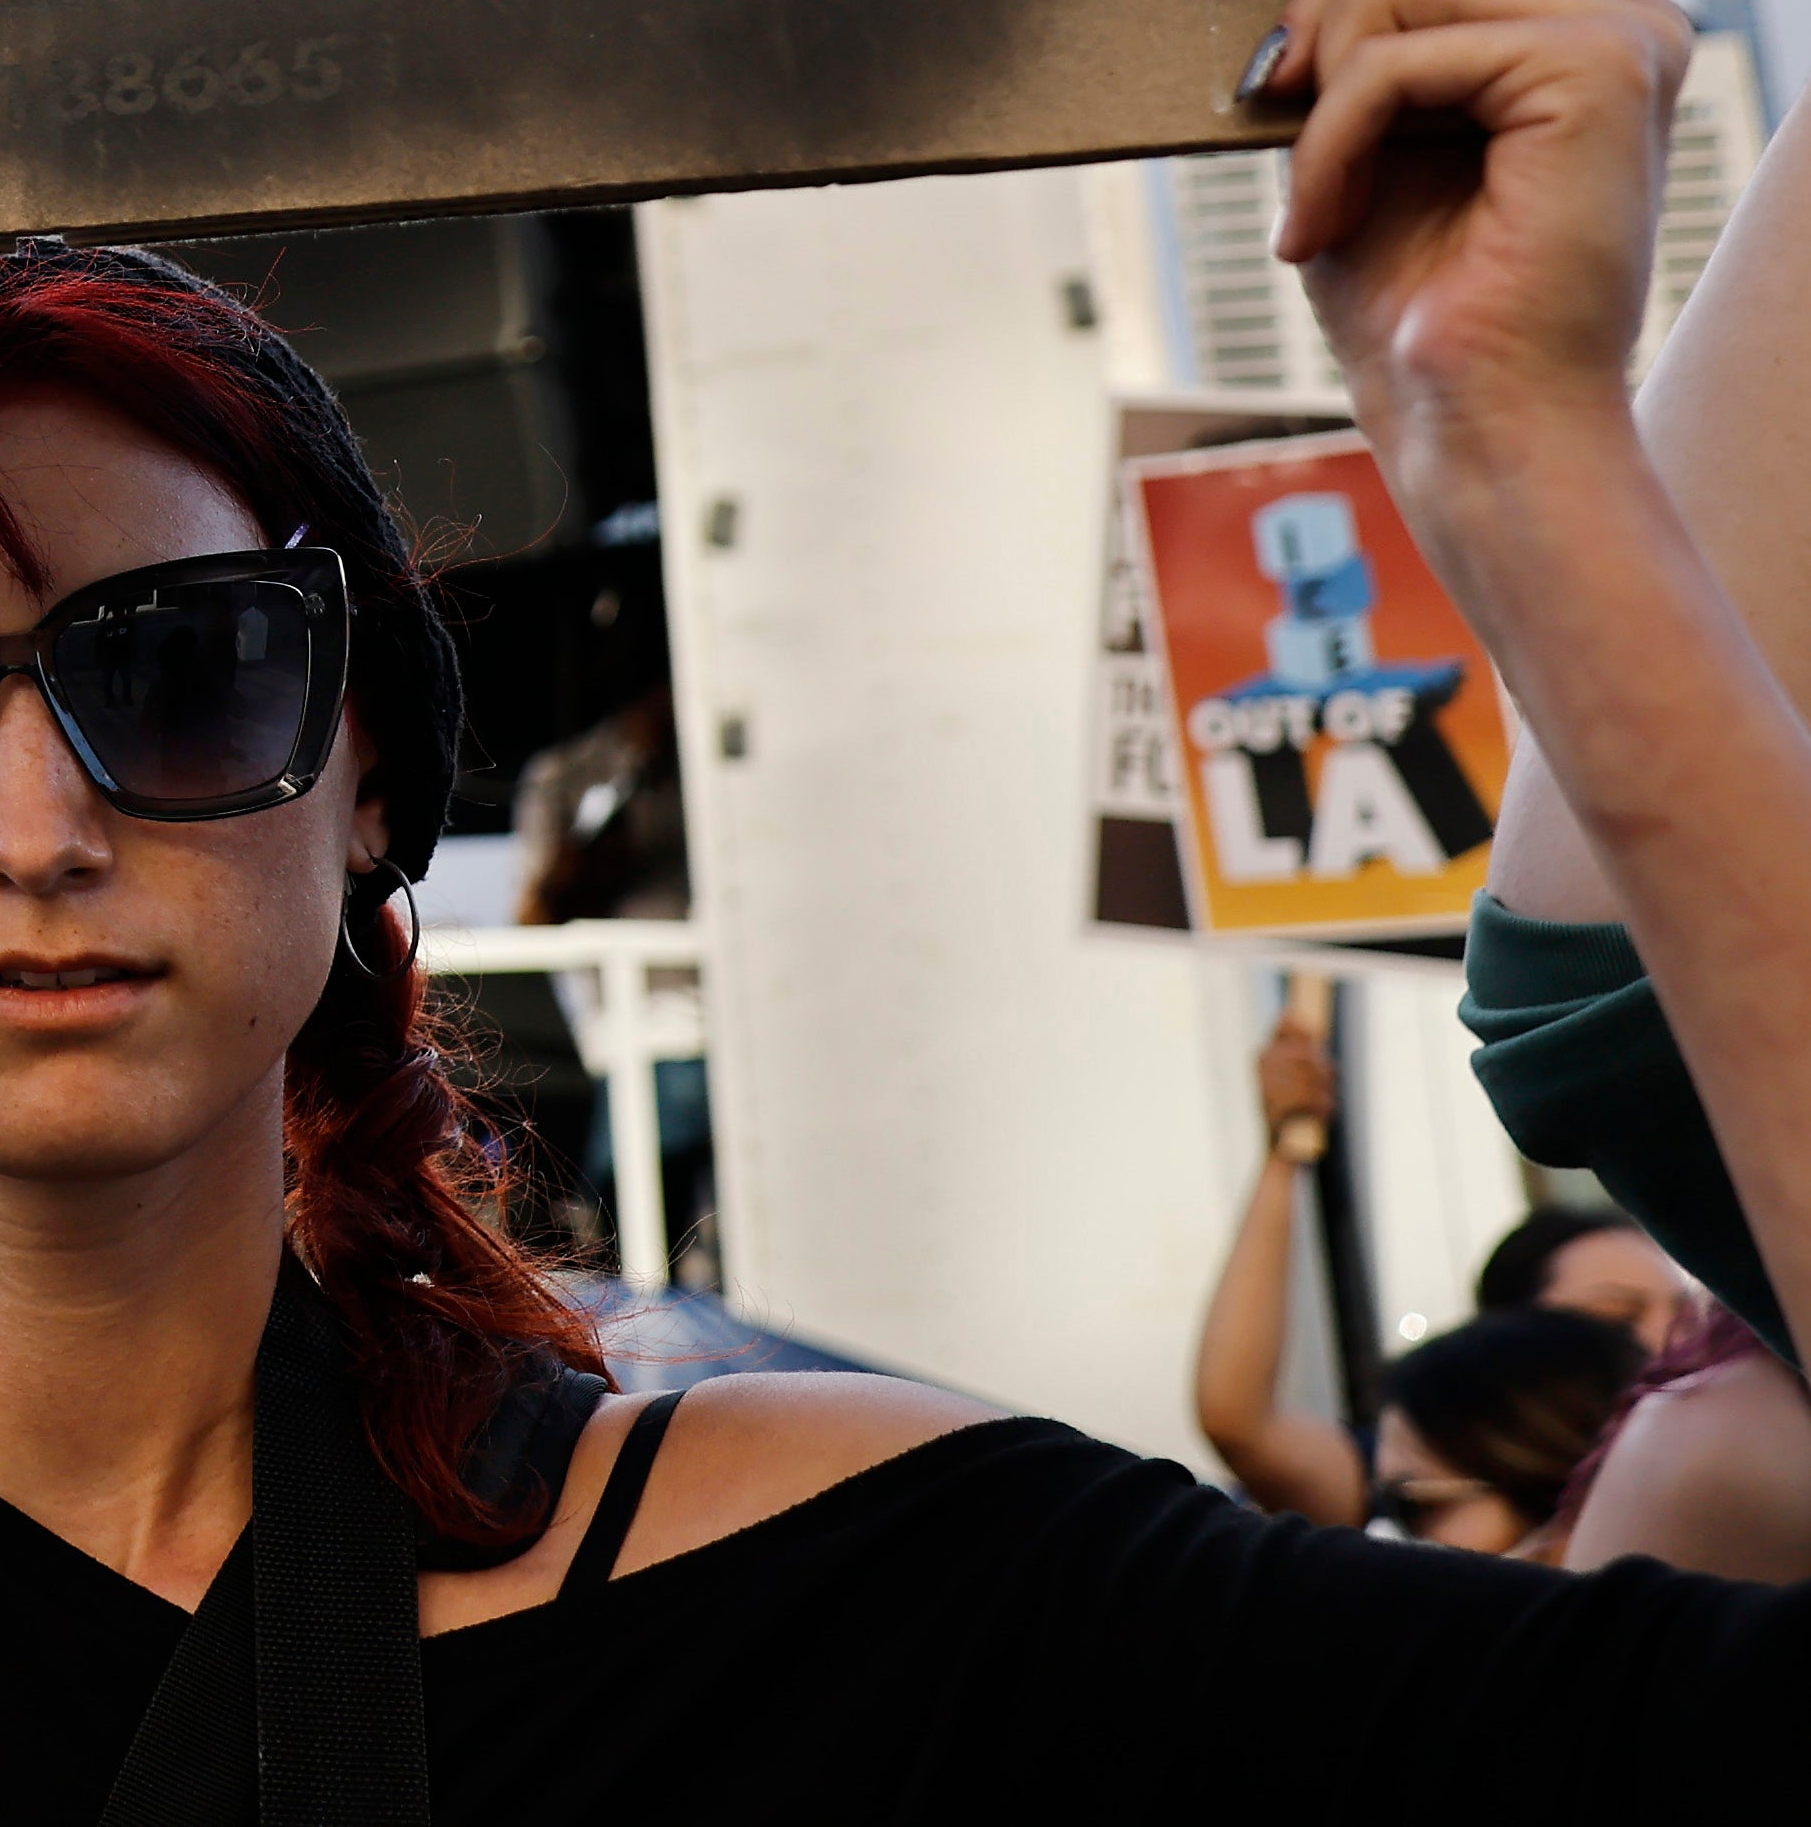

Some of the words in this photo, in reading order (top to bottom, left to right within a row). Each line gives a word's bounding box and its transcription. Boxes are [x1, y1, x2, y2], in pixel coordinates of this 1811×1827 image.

[1190, 700, 1317, 750] OUT
[1323, 689, 1416, 742] OF
[1203, 740, 1448, 883] LA
